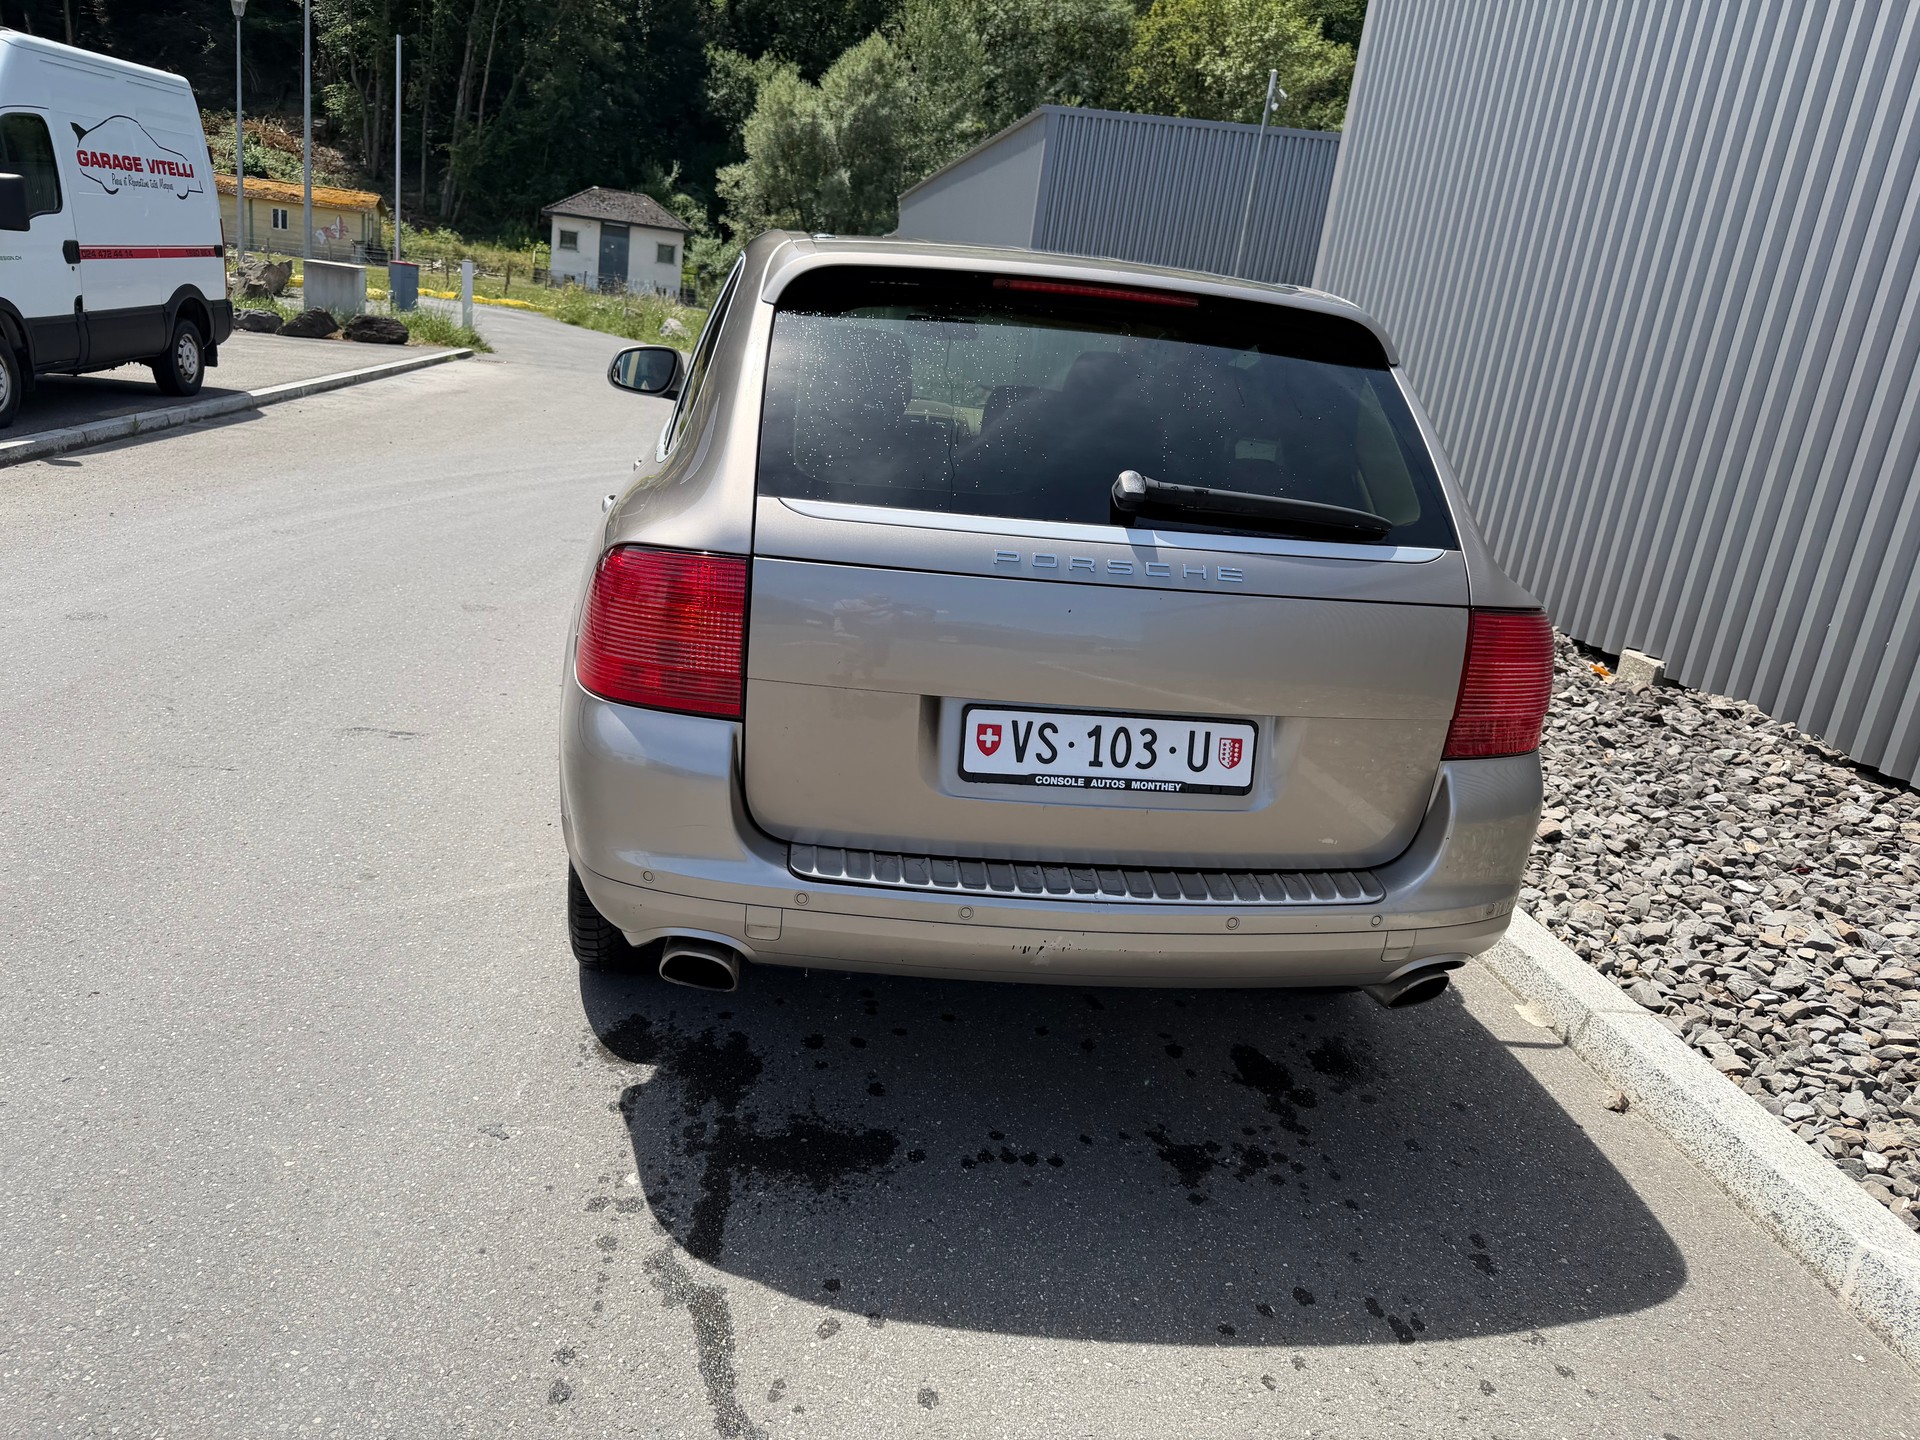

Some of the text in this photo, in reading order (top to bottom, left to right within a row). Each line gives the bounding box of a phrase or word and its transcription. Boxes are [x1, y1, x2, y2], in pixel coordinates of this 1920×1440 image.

[76, 149, 195, 179] GARAGE VITELLI
[993, 549, 1243, 583] PORSCHE
[1035, 775, 1182, 792] CONSOLE AUTOS MONTHEY
